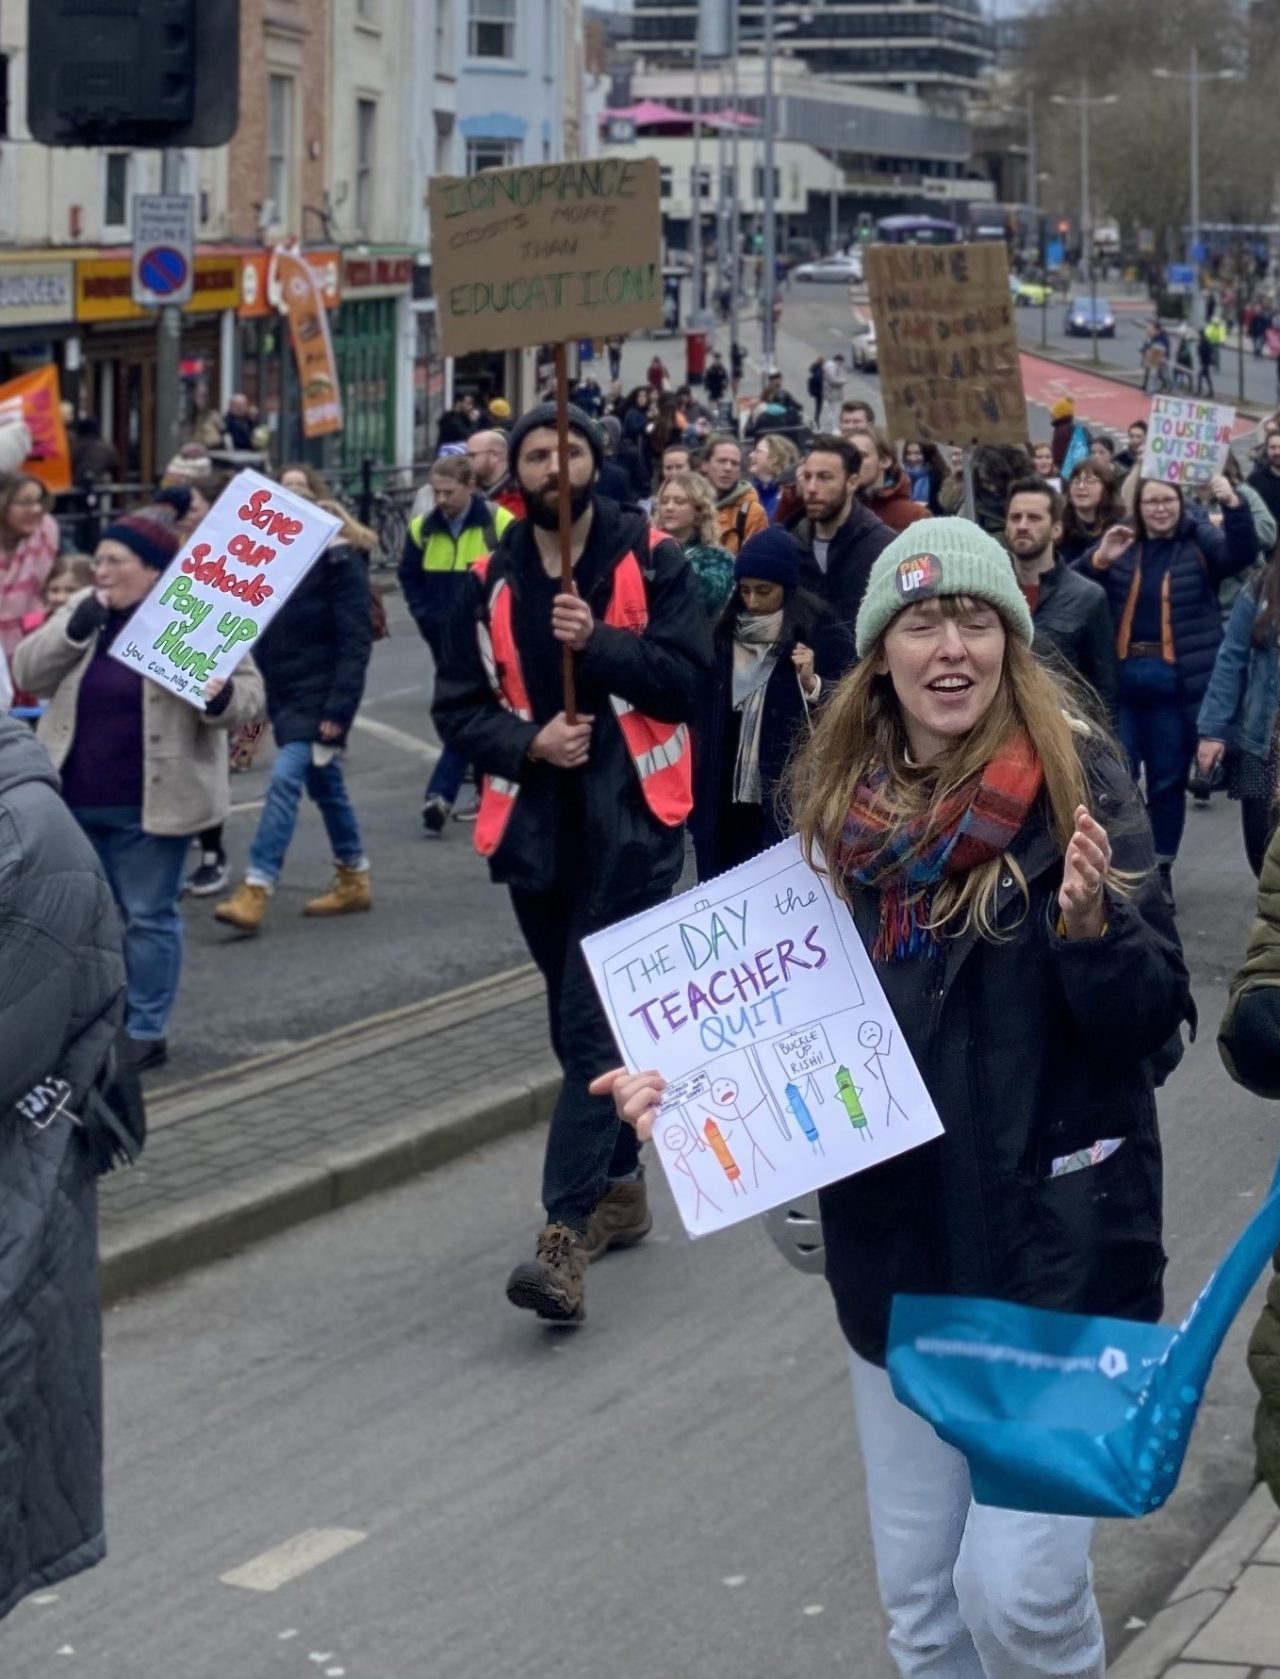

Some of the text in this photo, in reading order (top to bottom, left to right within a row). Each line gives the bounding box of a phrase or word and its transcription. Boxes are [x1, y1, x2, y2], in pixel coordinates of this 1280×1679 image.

[440, 160, 643, 219] IGNORANCE
[141, 227, 186, 242] ZONE
[450, 204, 618, 249] COSTS MORE
[521, 237, 578, 260] THAN
[449, 263, 657, 316] EDUCATION!
[1154, 415, 1231, 444] TO USE OUR
[1186, 402, 1220, 423] TIME
[1151, 436, 1220, 462] OUTSIDE
[237, 489, 304, 545] Save
[181, 543, 274, 607] Schools
[900, 556, 929, 576] PAY
[158, 575, 259, 653] Pay up
[153, 620, 224, 683] Hunt
[612, 886, 818, 993] THE DAY the
[629, 925, 828, 1046] TEACHERS
[699, 986, 789, 1053] QUIT
[779, 1030, 819, 1055] BUCKLE
